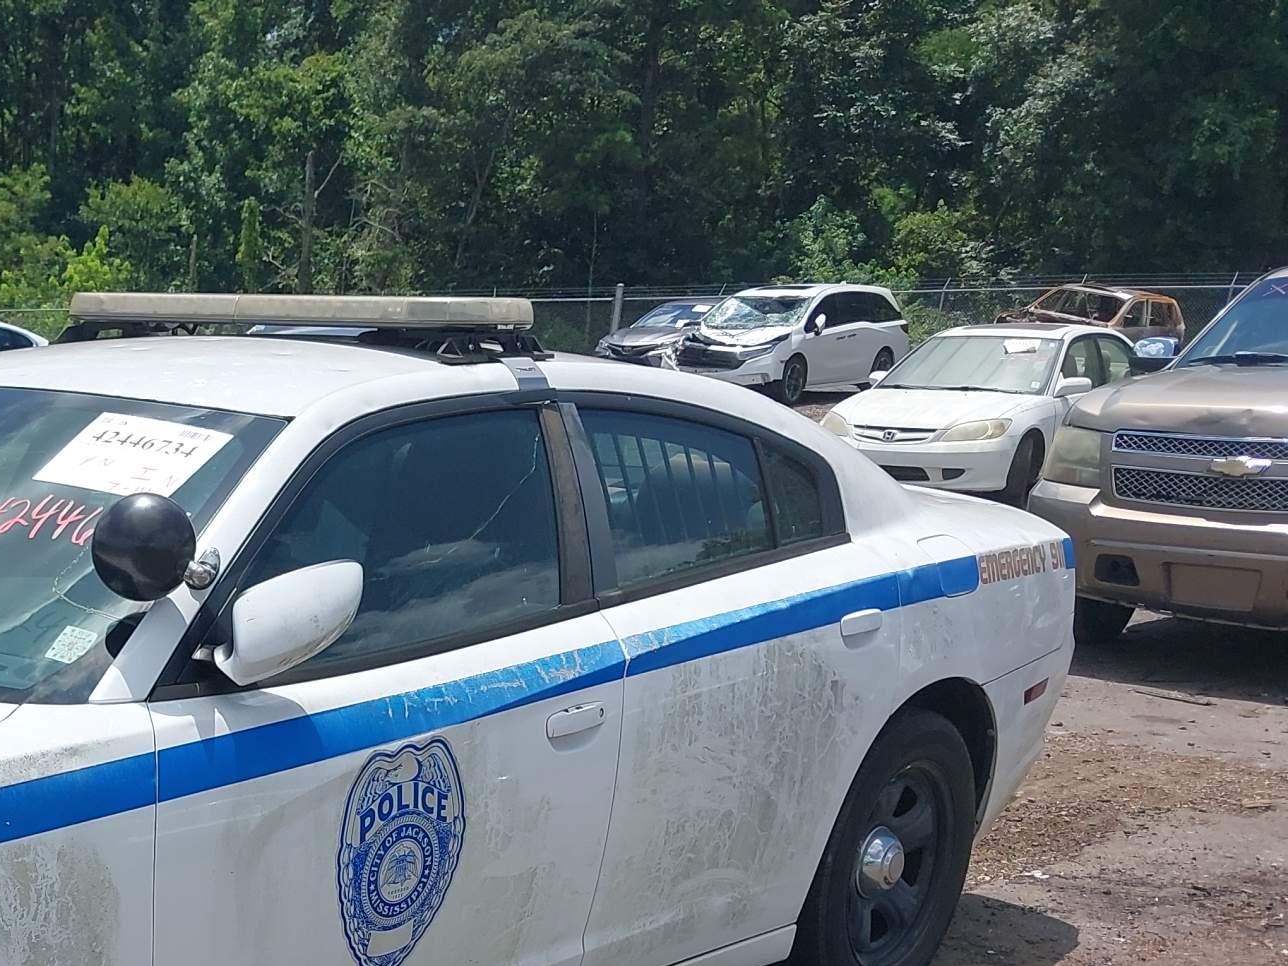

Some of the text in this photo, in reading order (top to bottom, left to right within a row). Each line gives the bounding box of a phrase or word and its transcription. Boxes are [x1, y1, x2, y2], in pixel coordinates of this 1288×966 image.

[91, 429, 199, 458] 42446734
[360, 782, 449, 844] POLICE
[369, 826, 433, 882] CITY OF JACKSON
[369, 877, 428, 916] MISSISSIPPI
